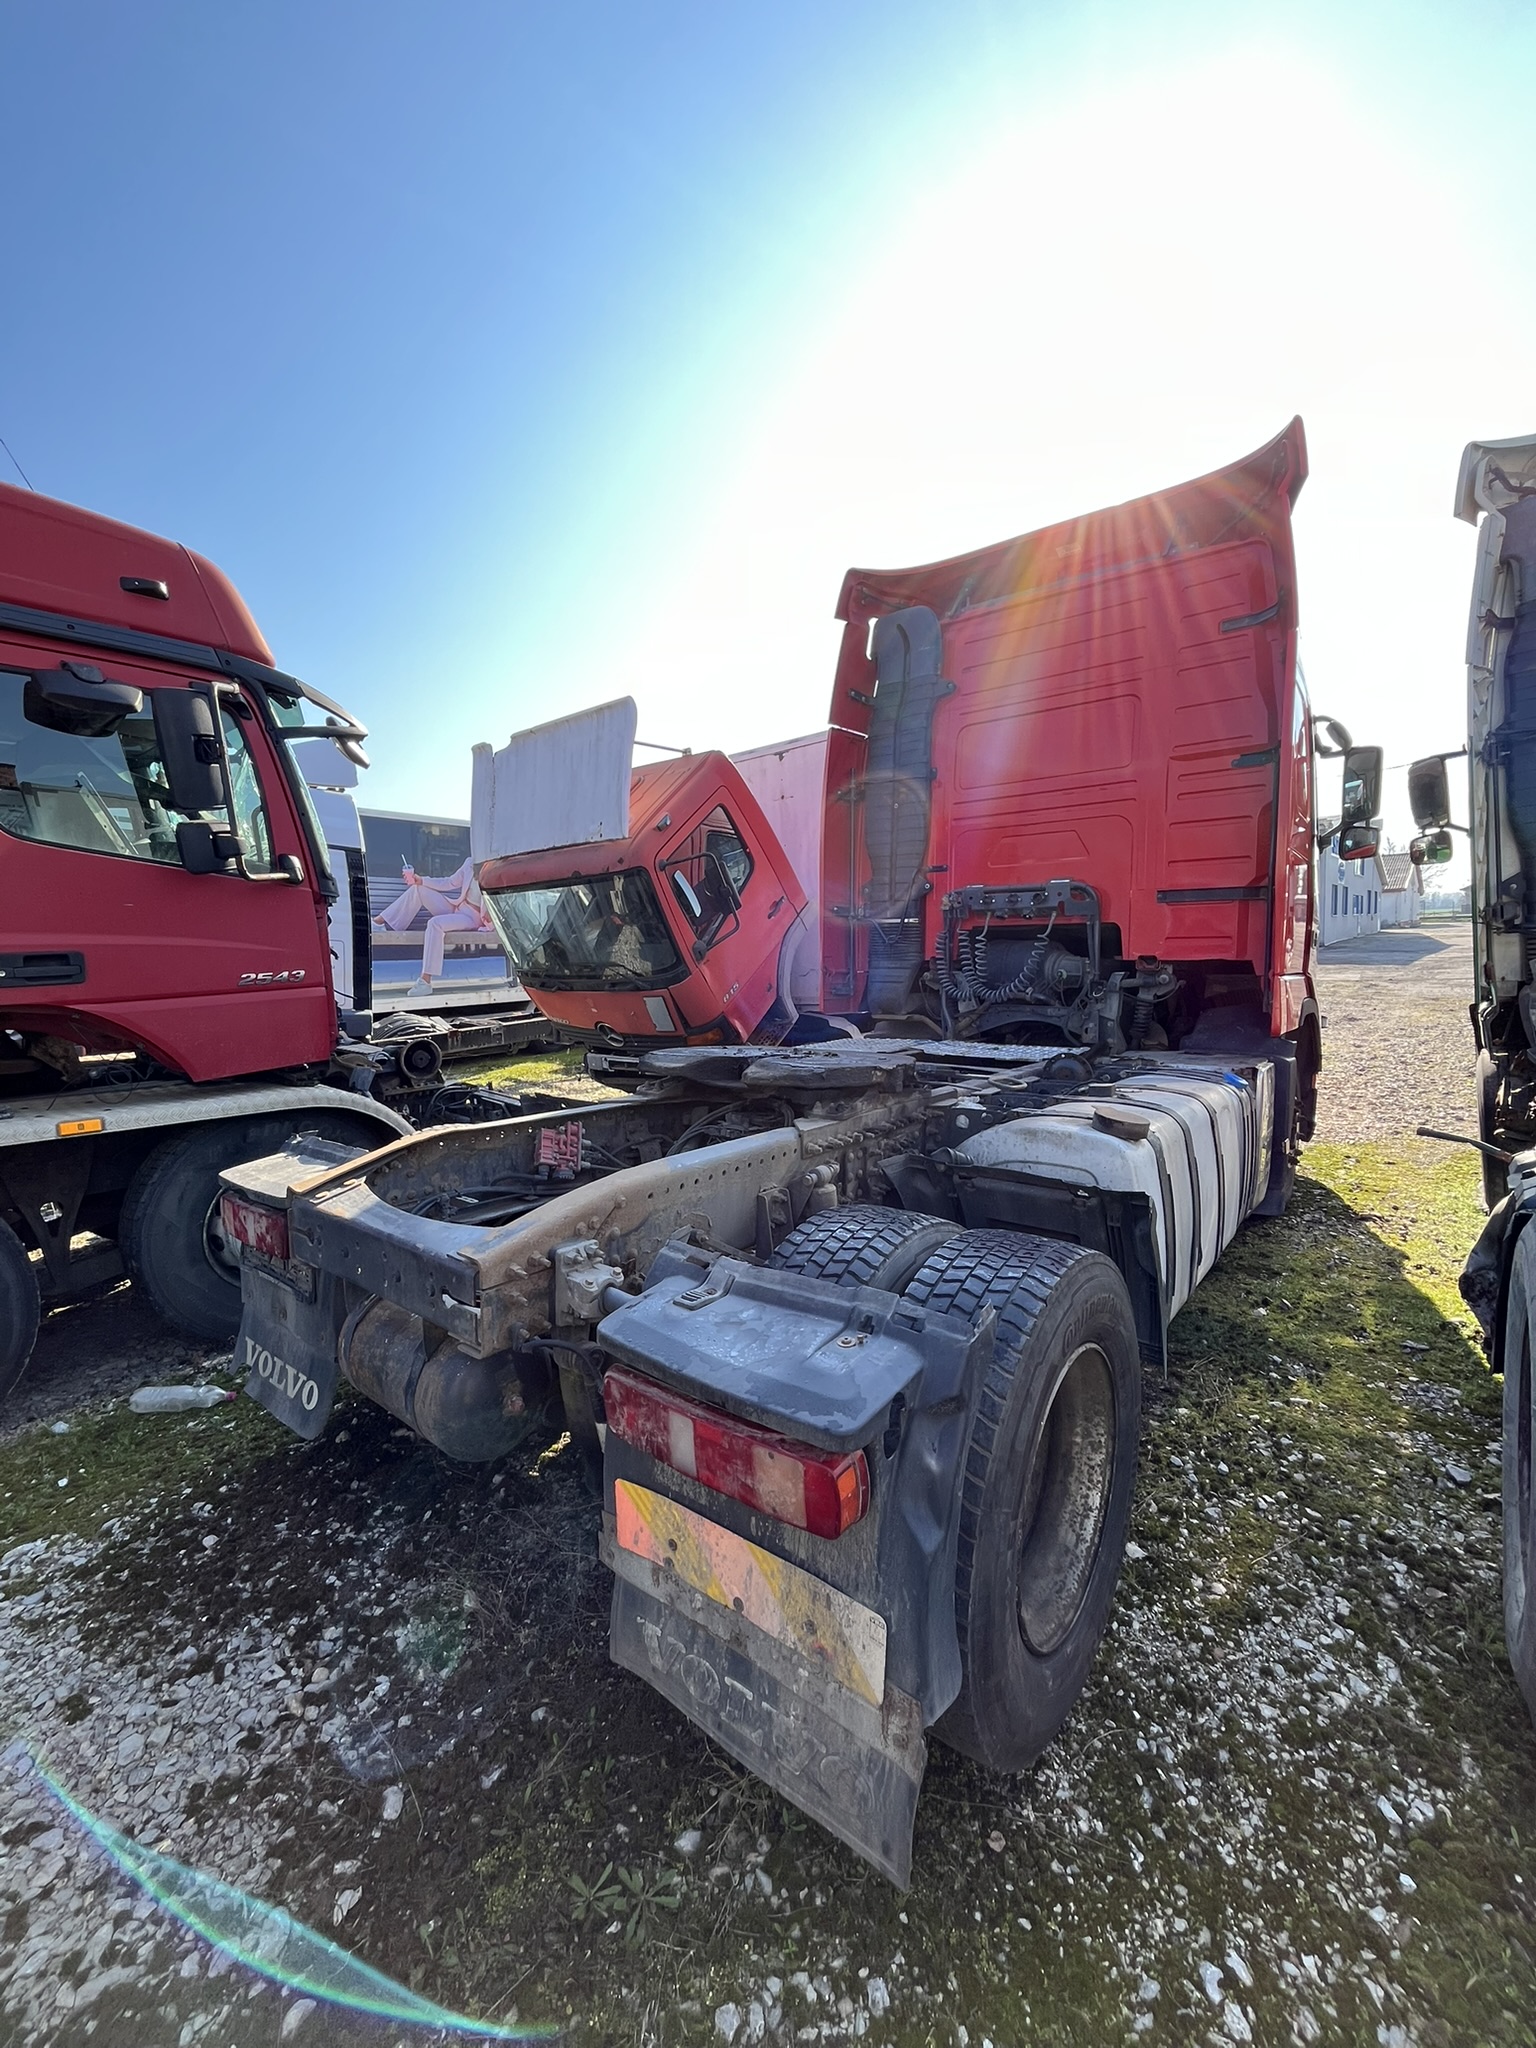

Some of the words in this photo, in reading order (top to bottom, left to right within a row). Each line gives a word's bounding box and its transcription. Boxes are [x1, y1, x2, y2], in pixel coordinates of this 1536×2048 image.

[238, 969, 306, 986] 2543
[245, 1336, 319, 1411] VOLVO
[636, 1614, 876, 1817] VOLVO
